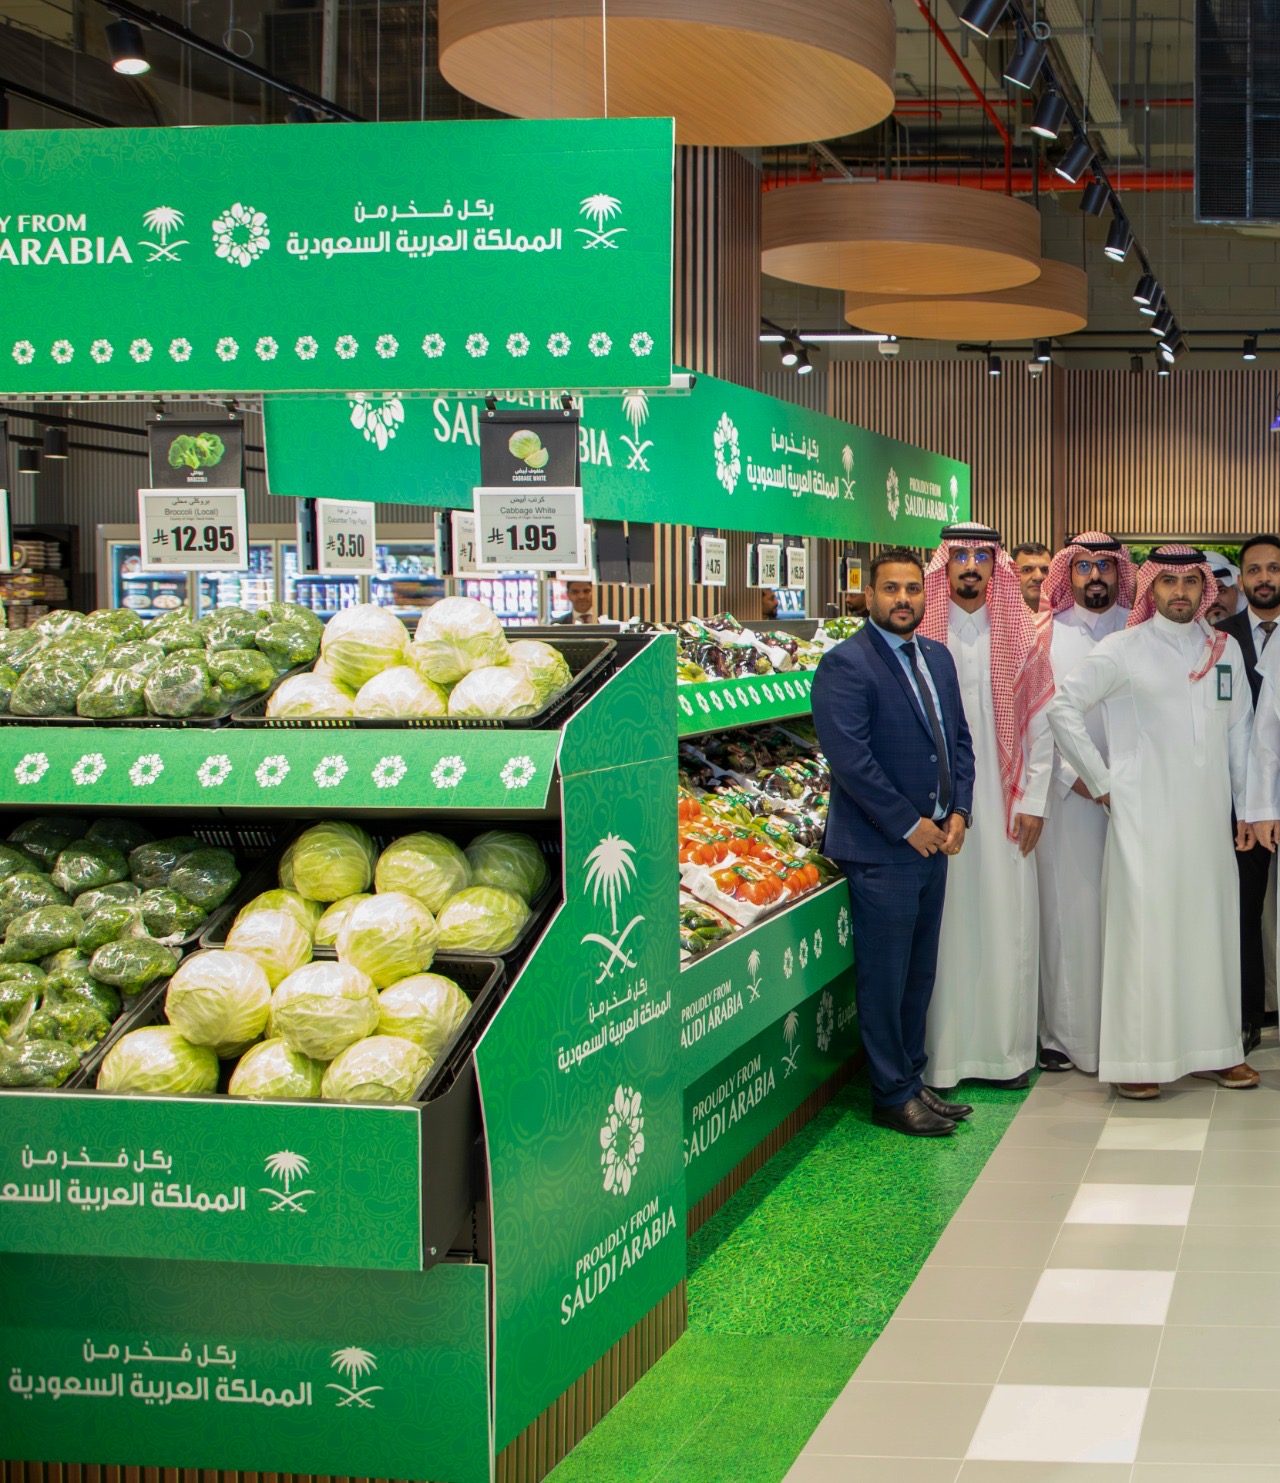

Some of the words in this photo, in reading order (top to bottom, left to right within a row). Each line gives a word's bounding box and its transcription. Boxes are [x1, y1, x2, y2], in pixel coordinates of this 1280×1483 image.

[354, 201, 388, 223] من
[390, 199, 453, 222] فخر
[458, 199, 494, 220] بكل
[18, 213, 87, 233] FROM
[286, 231, 391, 260] السعودية
[396, 229, 468, 258] العربية
[473, 228, 562, 253] المملكة
[164, 508, 193, 516] Broccoli
[194, 508, 219, 517] (Local)
[500, 506, 533, 517] Cabbage
[535, 506, 556, 514] White
[904, 493, 926, 519] SAUDI
[926, 498, 949, 522] ARABIA
[170, 525, 235, 551] 12.95
[337, 533, 365, 558] 3.50
[506, 525, 557, 551] 1.95
[710, 559, 721, 575] 4.75
[765, 564, 775, 578] 7.95
[640, 990, 671, 1025] المملكة
[681, 990, 713, 1024] PROUDLY
[713, 979, 731, 1003] FROM
[609, 1008, 639, 1047] العربية
[680, 1014, 706, 1049] AUDI
[707, 990, 743, 1033] ARABIA
[558, 1025, 608, 1074] السعودية
[692, 1074, 736, 1126] PROUDLY
[737, 1054, 761, 1089] FROM
[728, 1066, 776, 1129] ARABIA
[22, 1144, 58, 1168] من
[61, 1147, 129, 1170] فخر
[133, 1149, 172, 1174] بكل
[67, 1178, 145, 1211] العربية
[151, 1182, 246, 1213] المملكة
[576, 1220, 629, 1281] PROUDLY
[630, 1195, 659, 1235] FROM
[560, 1254, 616, 1326] SAUDI
[620, 1205, 676, 1276] ARABIA
[83, 1338, 120, 1362] من
[124, 1340, 192, 1364] فخر
[197, 1344, 237, 1370] بكل
[9, 1368, 124, 1401] السعودية
[130, 1373, 209, 1405] العربية
[215, 1377, 313, 1408] المملكة
